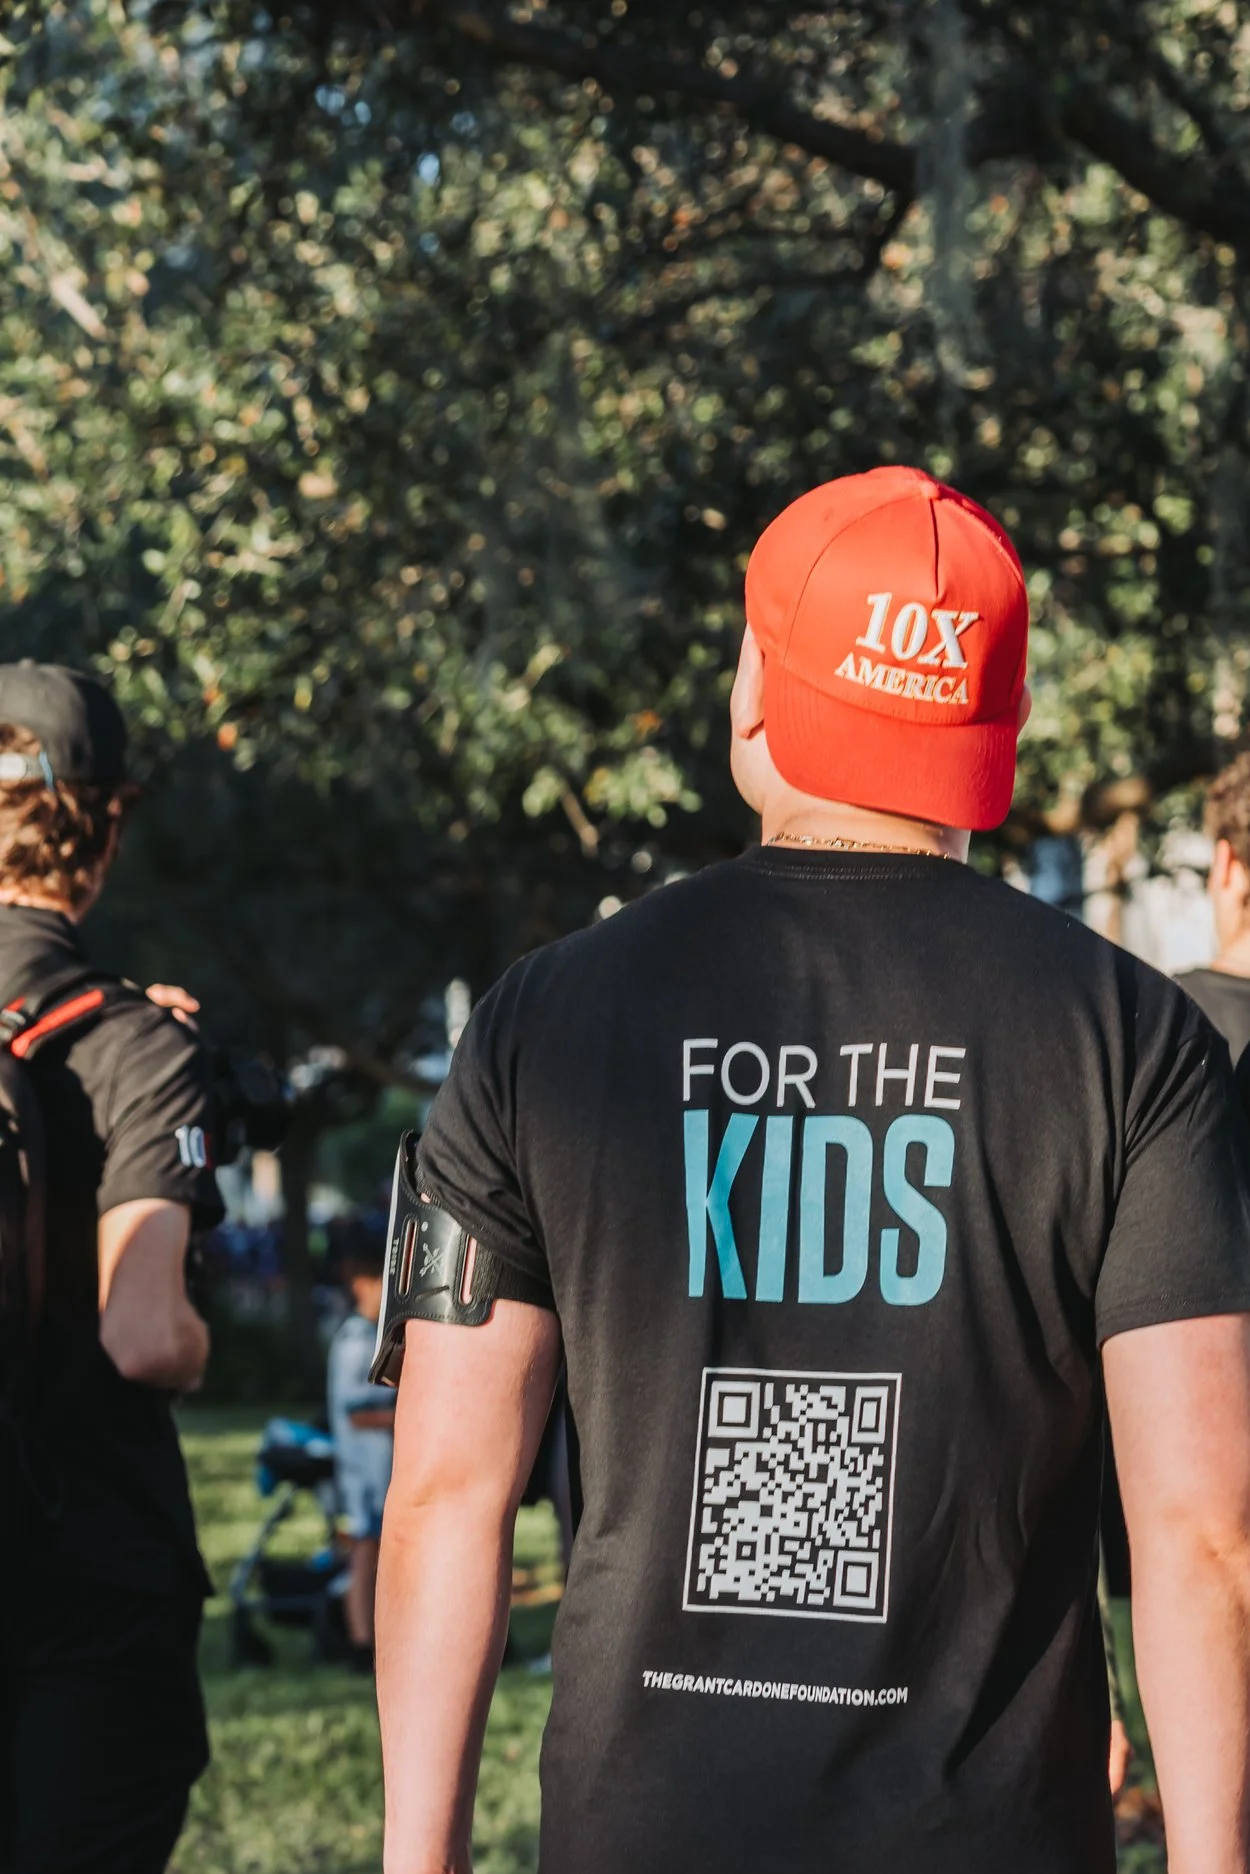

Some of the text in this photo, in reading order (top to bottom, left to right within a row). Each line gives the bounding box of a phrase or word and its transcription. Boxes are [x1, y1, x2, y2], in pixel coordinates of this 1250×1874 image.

[856, 592, 980, 669] 10X
[834, 652, 969, 704] AMERICA
[683, 1038, 966, 1110] FOR THE
[683, 1109, 956, 1306] KIDS
[642, 1671, 909, 1706] THEGRANTCARDONEFOUNDATION.COM
